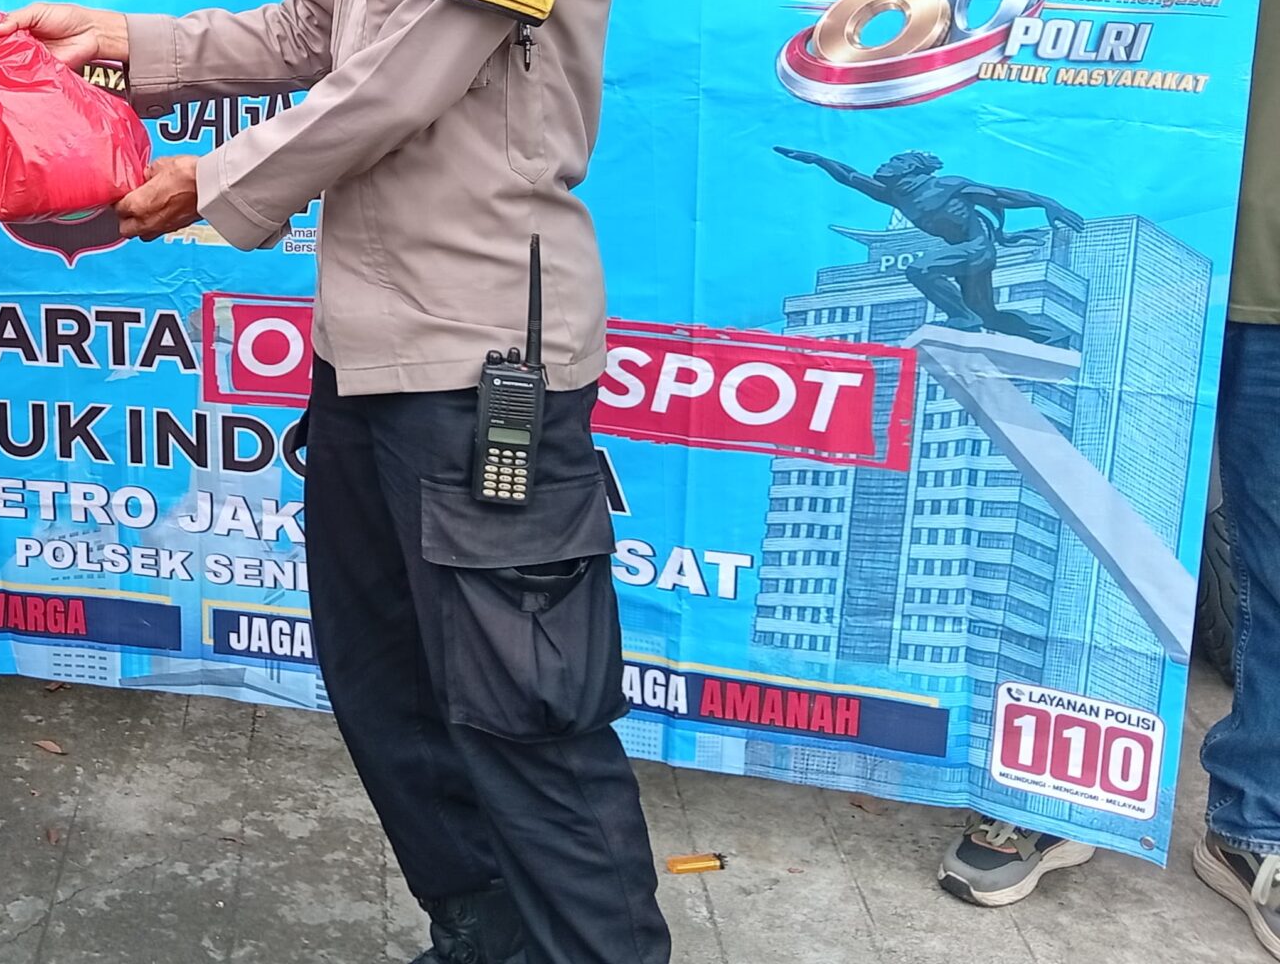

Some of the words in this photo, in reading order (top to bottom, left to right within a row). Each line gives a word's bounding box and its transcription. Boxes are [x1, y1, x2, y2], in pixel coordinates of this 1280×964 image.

[1003, 16, 1154, 63] POLRI
[977, 62, 1051, 84] UNTUK
[1055, 67, 1210, 94] MASYARAKAT
[597, 346, 864, 433] SPOT
[15, 537, 194, 582] POLSEK
[228, 615, 314, 659] JAGA
[699, 678, 861, 737] AMANAH
[1028, 690, 1100, 719] LAYANAN
[1104, 707, 1157, 733] POLISI
[1012, 713, 1146, 793] 110
